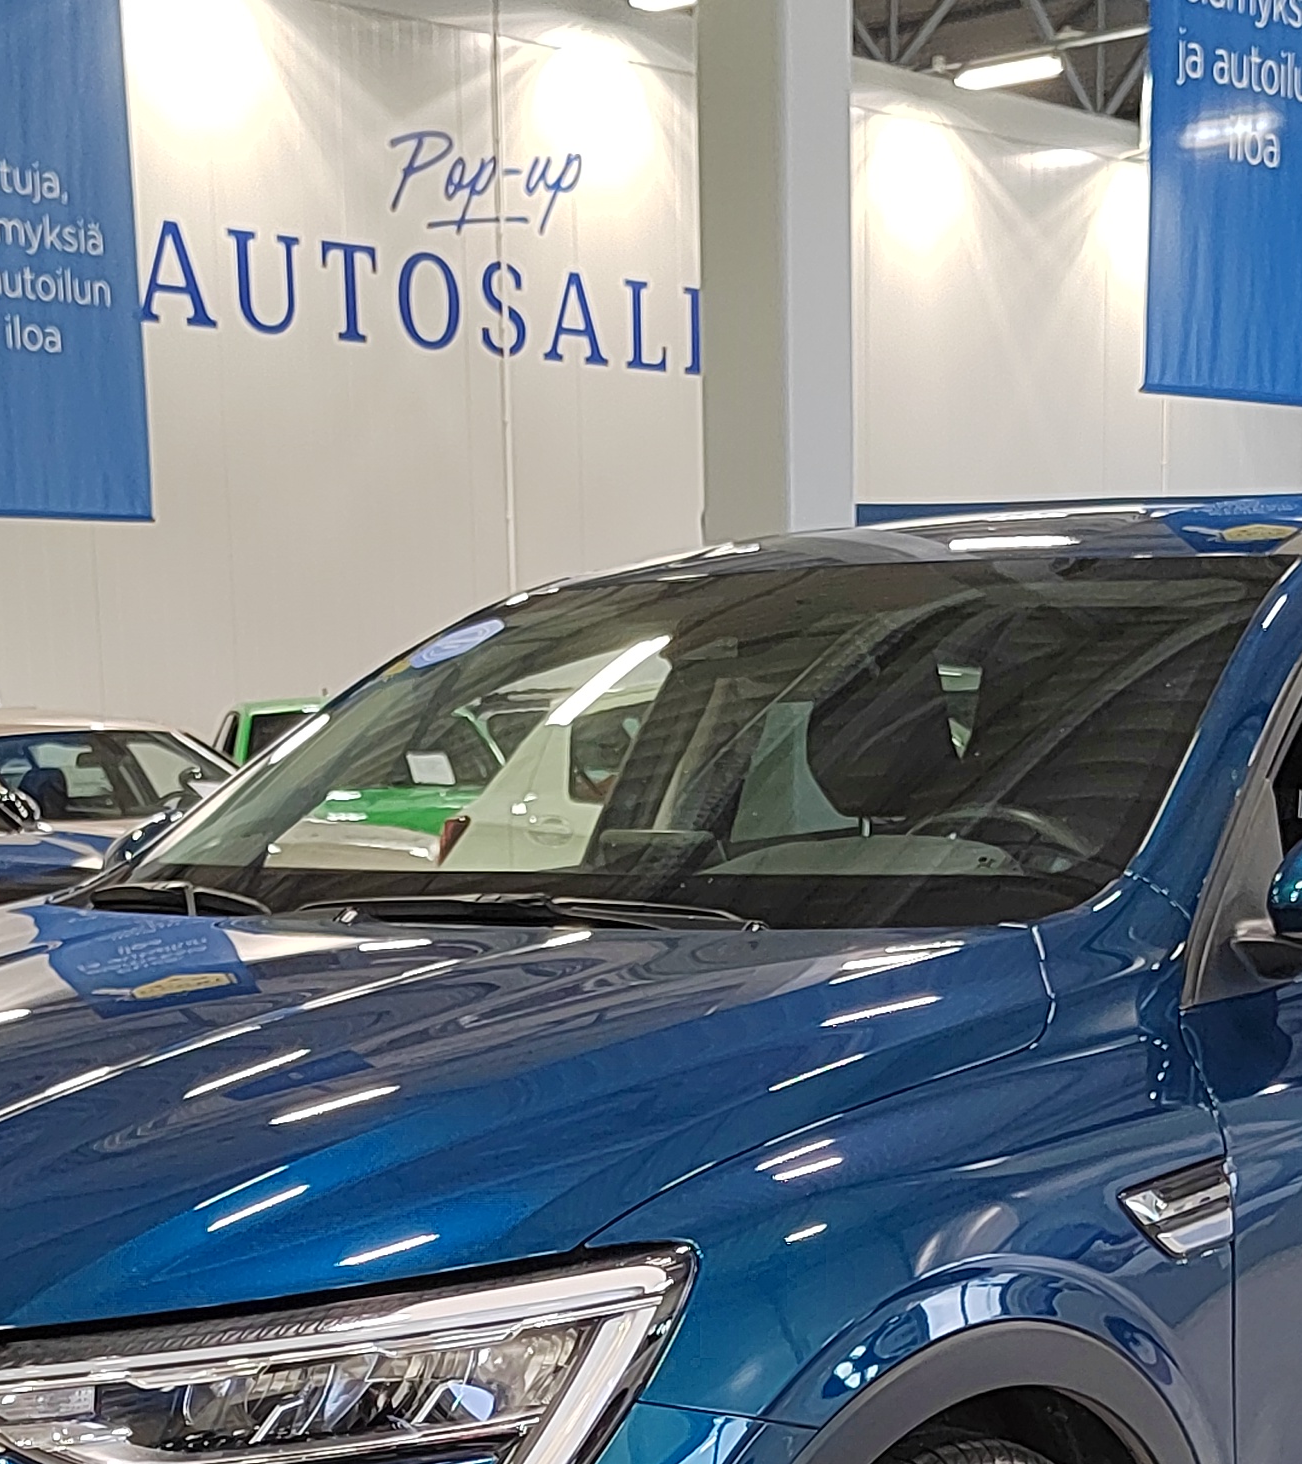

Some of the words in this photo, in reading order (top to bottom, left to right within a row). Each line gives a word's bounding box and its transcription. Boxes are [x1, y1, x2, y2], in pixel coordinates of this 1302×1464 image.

[1176, 27, 1205, 86] ja
[389, 130, 583, 236] Pop-up
[4, 312, 63, 354] iloa
